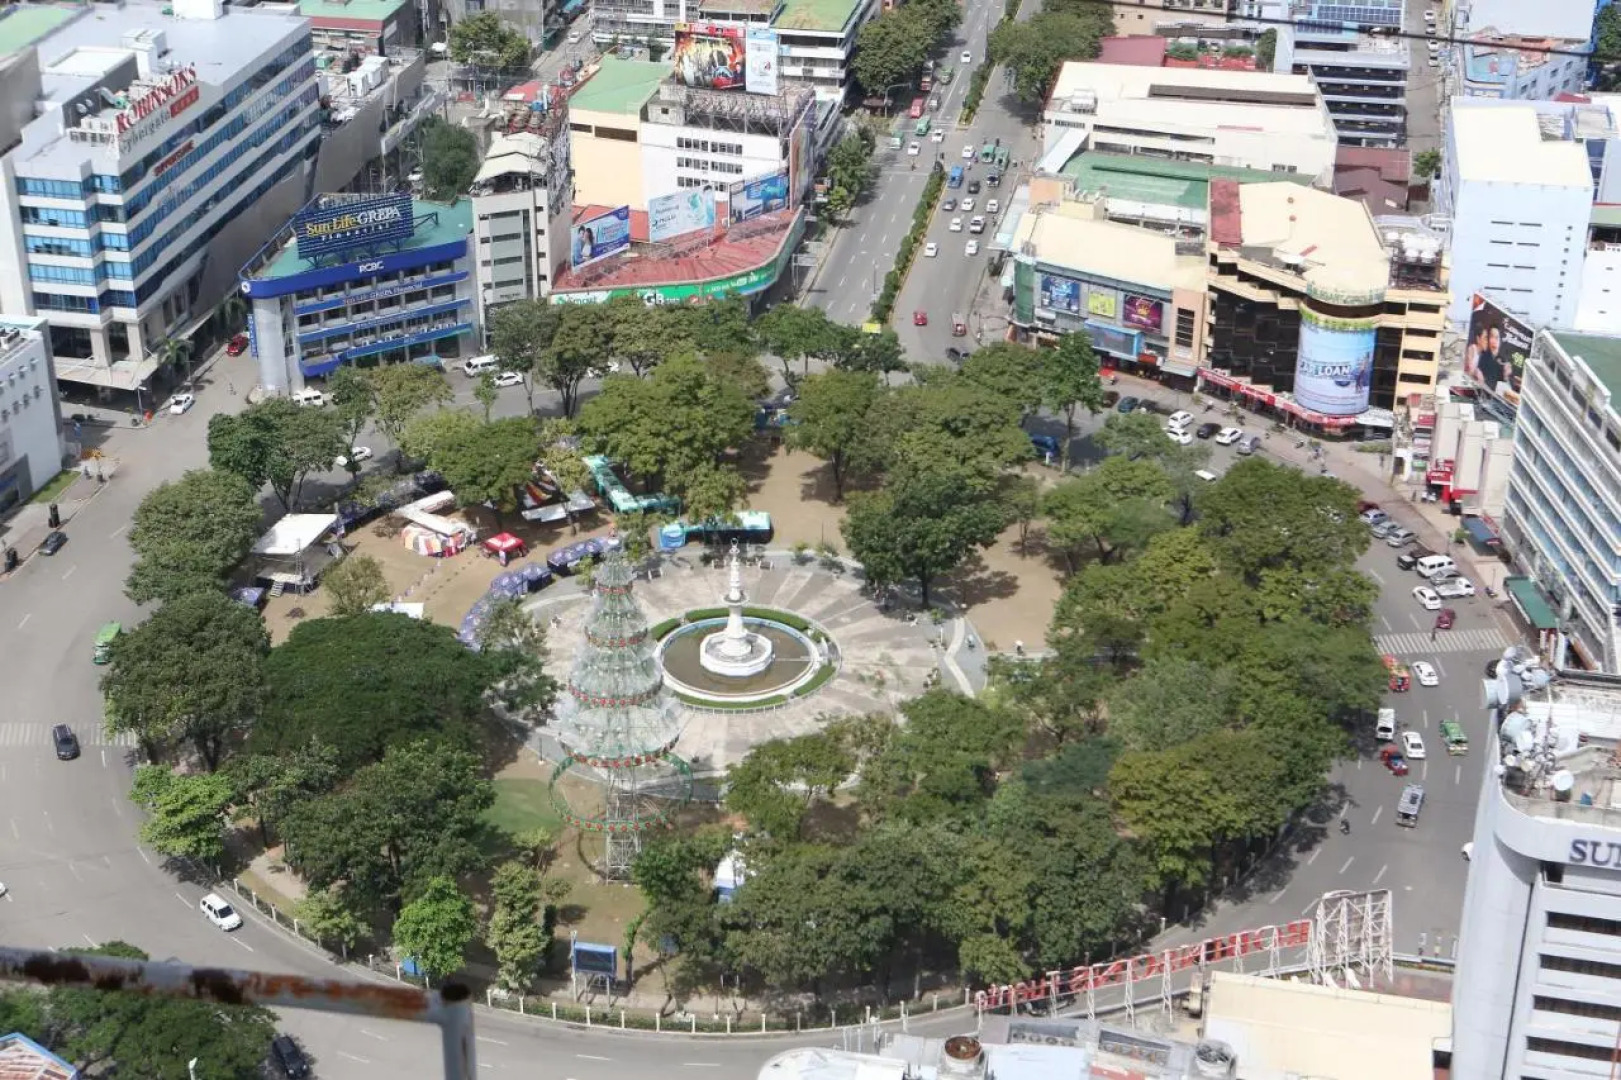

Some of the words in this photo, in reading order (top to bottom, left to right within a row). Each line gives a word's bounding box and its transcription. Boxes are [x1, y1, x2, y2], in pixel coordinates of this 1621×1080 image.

[305, 222, 331, 237] Sun
[333, 214, 354, 234] Life
[358, 205, 400, 225] GREPA
[1317, 364, 1351, 377] LOAN
